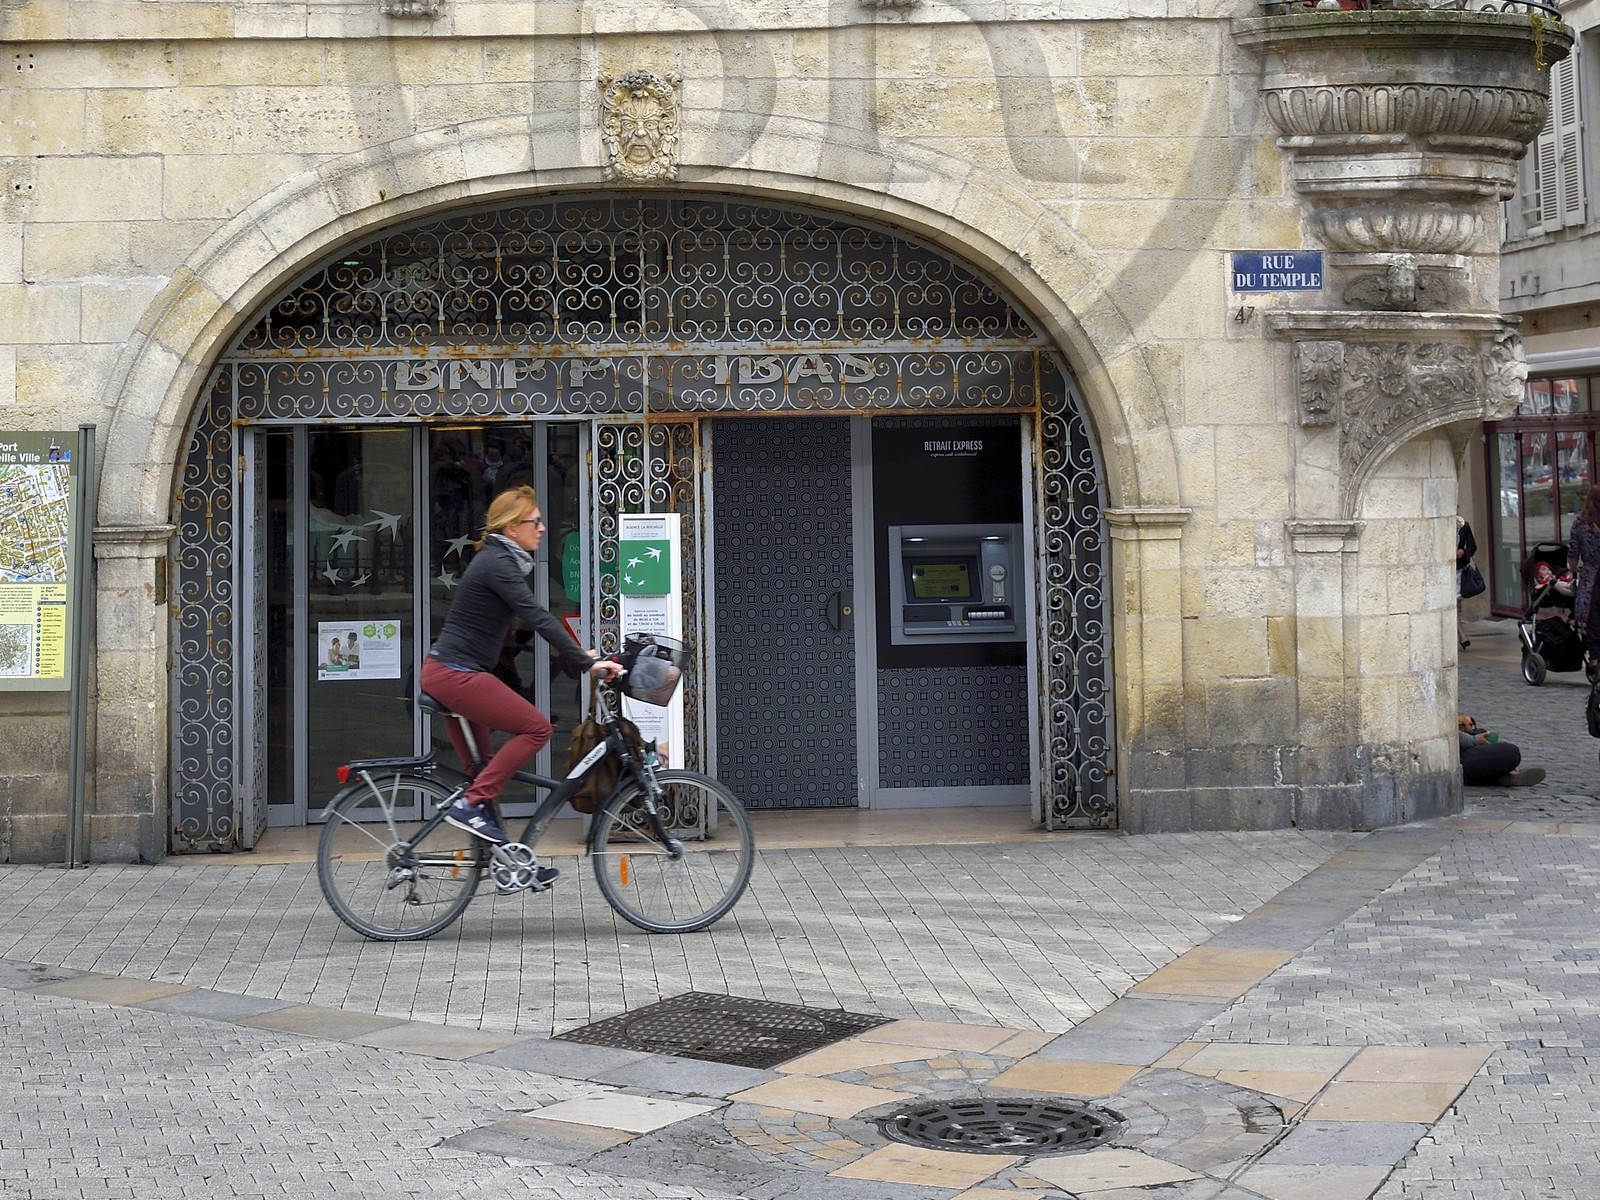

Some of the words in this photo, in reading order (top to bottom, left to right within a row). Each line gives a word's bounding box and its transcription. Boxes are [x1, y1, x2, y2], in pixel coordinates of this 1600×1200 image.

[1262, 255, 1294, 269] RUE
[1236, 273, 1256, 287] DU
[1260, 273, 1320, 287] TEMPLE
[1234, 306, 1255, 324] 47
[396, 359, 546, 390] BNP
[924, 441, 951, 451] RETRAIT
[953, 440, 983, 450] EXPRESS
[19, 453, 40, 462] Ville
